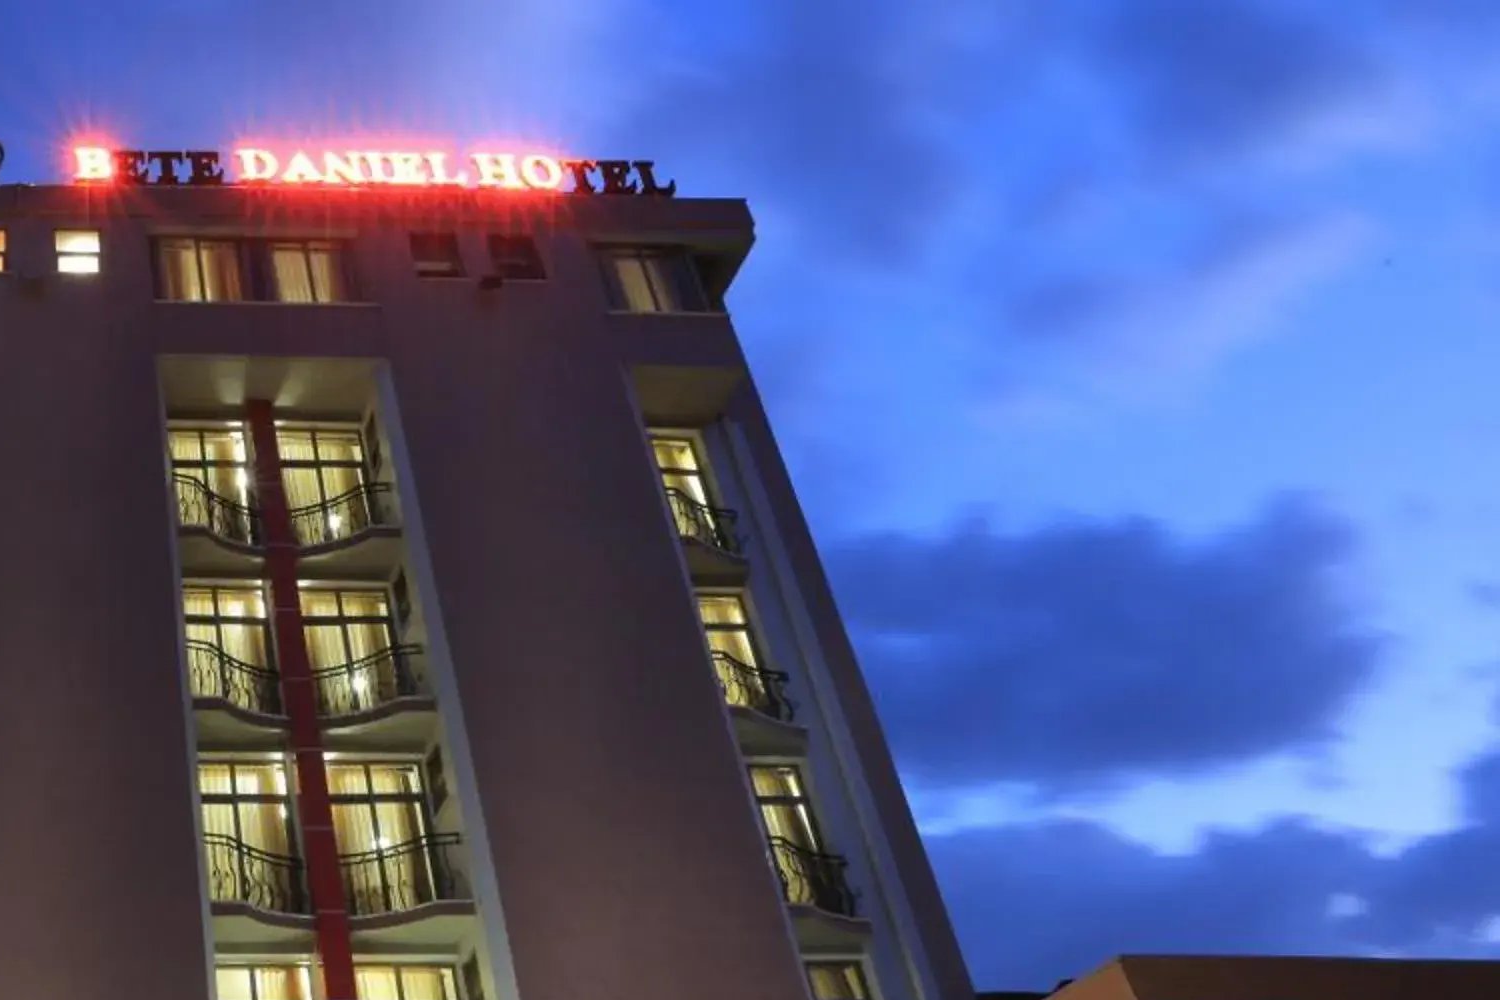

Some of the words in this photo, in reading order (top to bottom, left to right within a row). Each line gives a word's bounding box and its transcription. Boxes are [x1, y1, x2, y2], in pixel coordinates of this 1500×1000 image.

[74, 147, 224, 185] BETE
[236, 148, 468, 185] DANIEL
[471, 152, 677, 197] HOTEL
